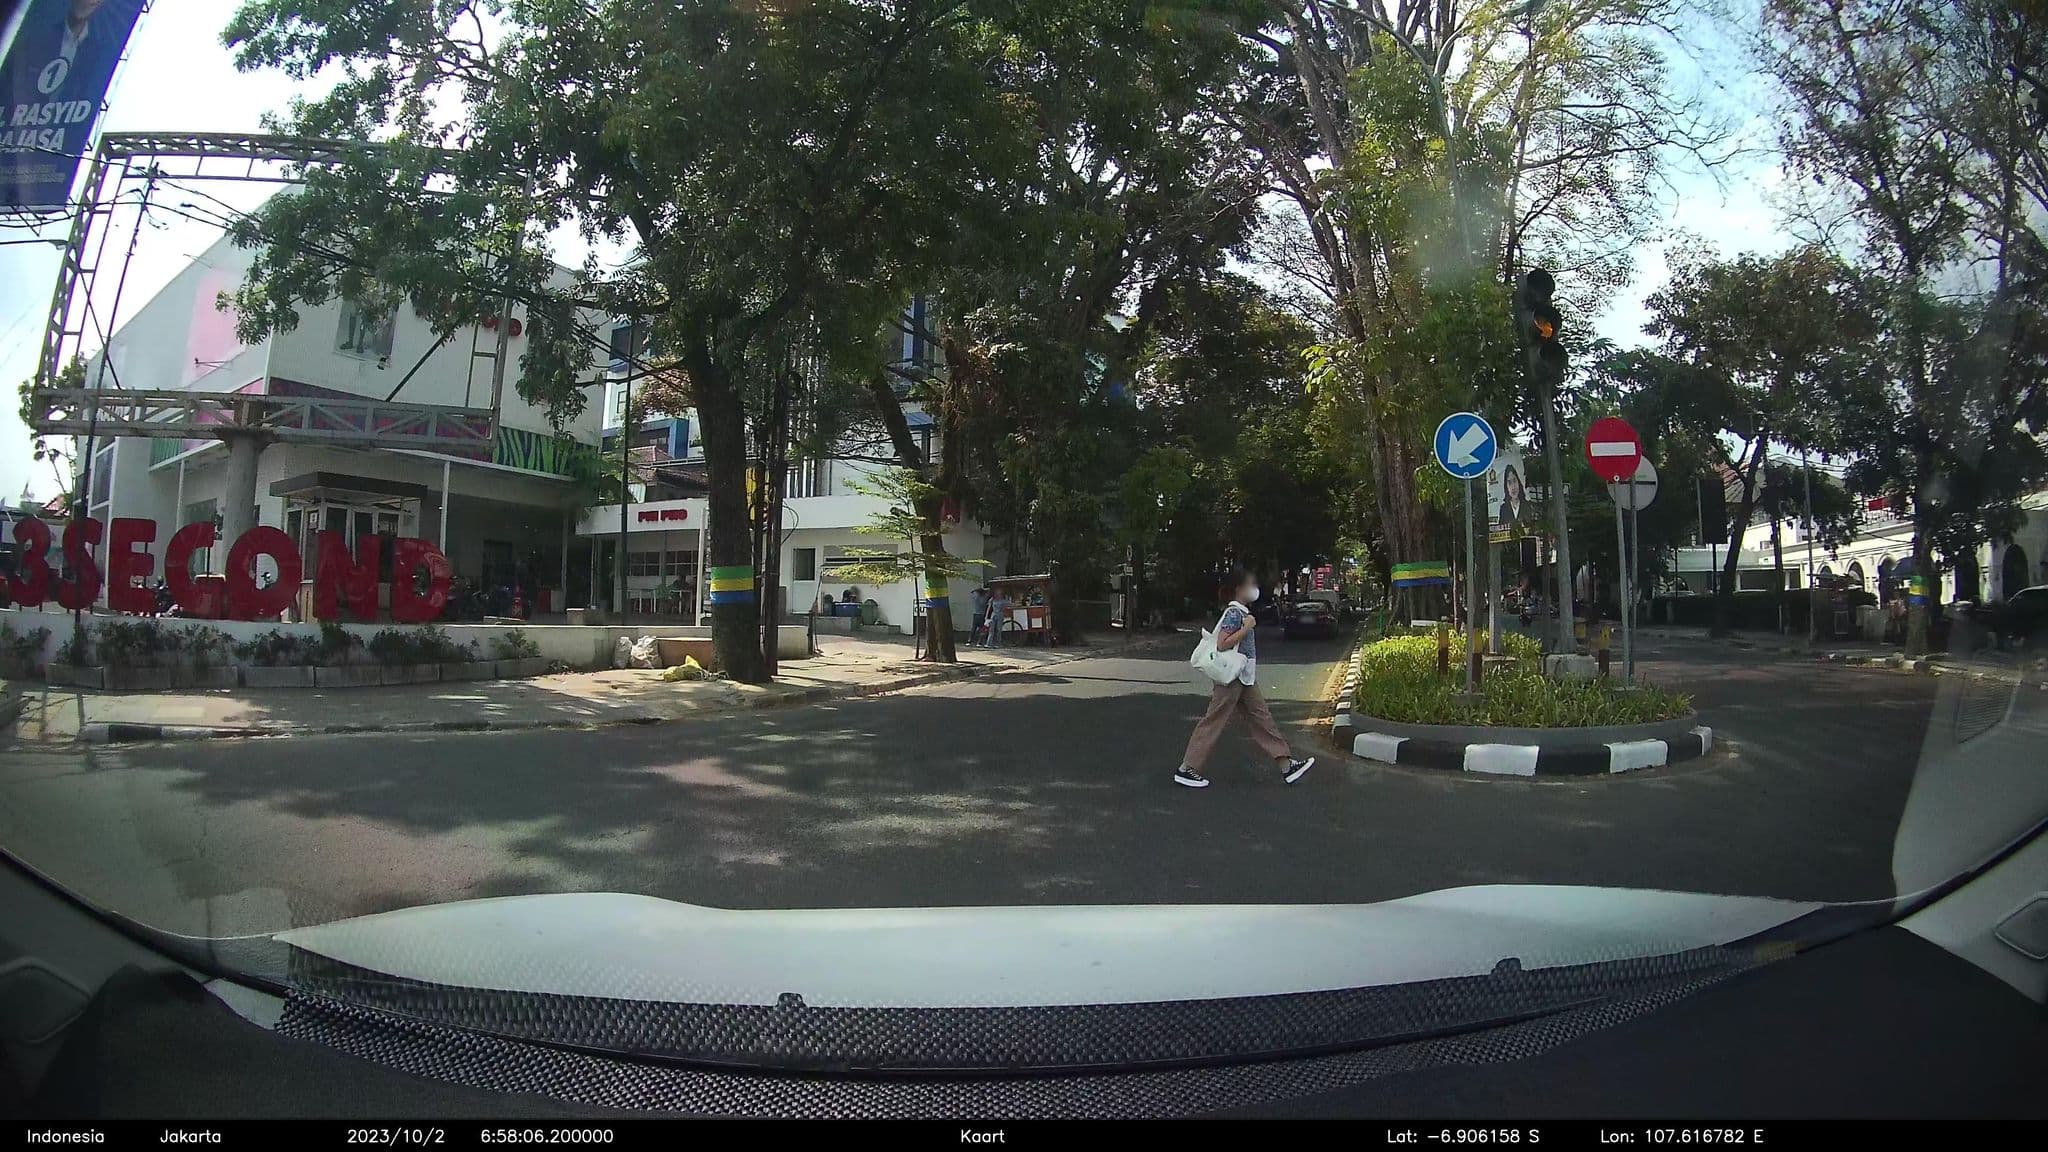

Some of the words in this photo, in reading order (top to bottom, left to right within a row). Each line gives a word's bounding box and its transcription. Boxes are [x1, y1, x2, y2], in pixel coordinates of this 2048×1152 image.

[45, 63, 60, 89] 1
[11, 100, 92, 126] RASYID
[0, 128, 65, 151] AJASA
[9, 516, 451, 625] 3SECOND
